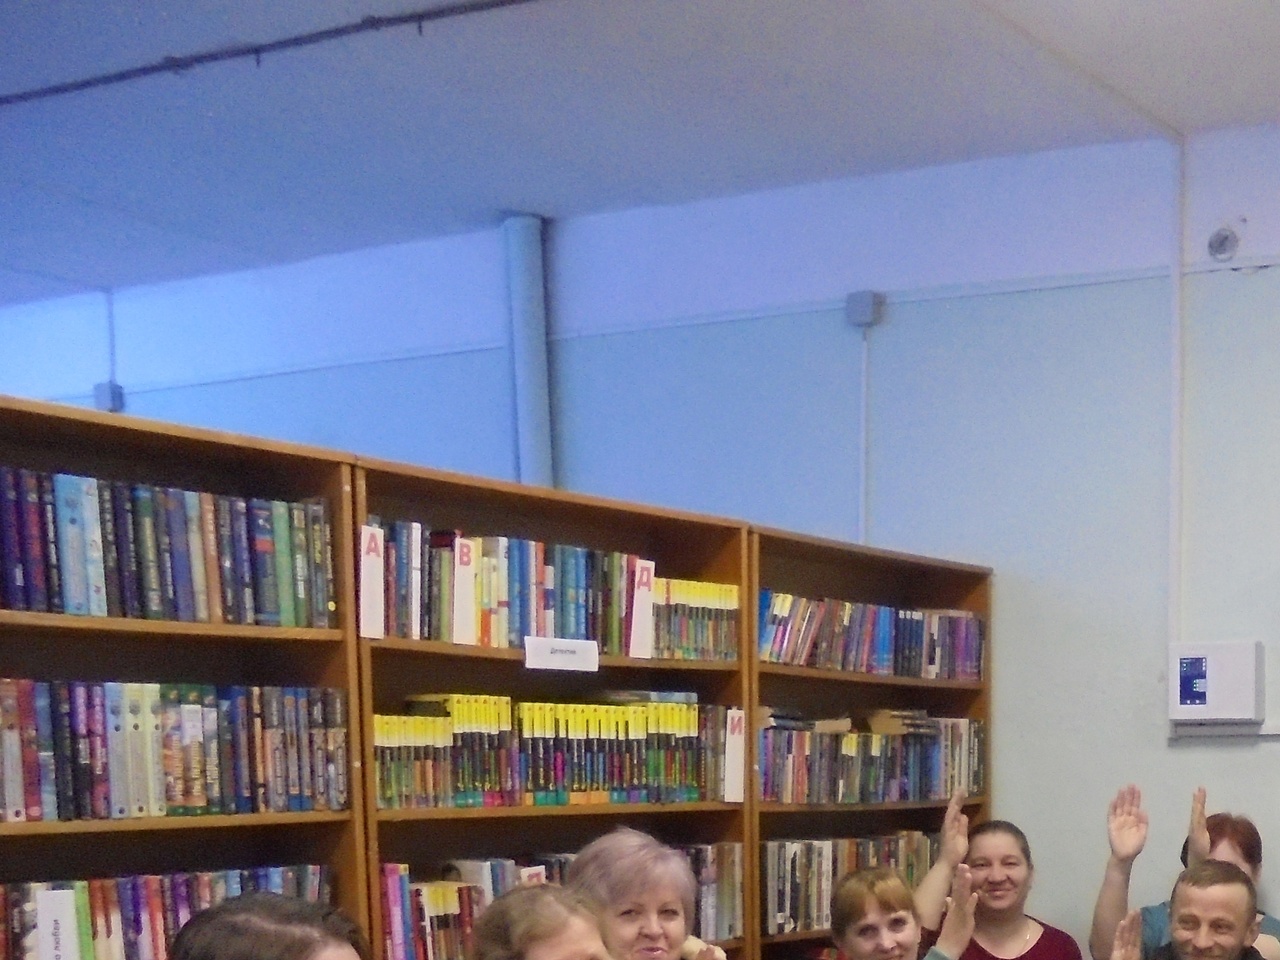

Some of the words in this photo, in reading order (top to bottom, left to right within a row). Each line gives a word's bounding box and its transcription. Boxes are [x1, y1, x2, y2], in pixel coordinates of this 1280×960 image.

[366, 532, 381, 557] А
[460, 543, 471, 566] В
[637, 566, 652, 592] Д
[52, 919, 60, 951] любви
